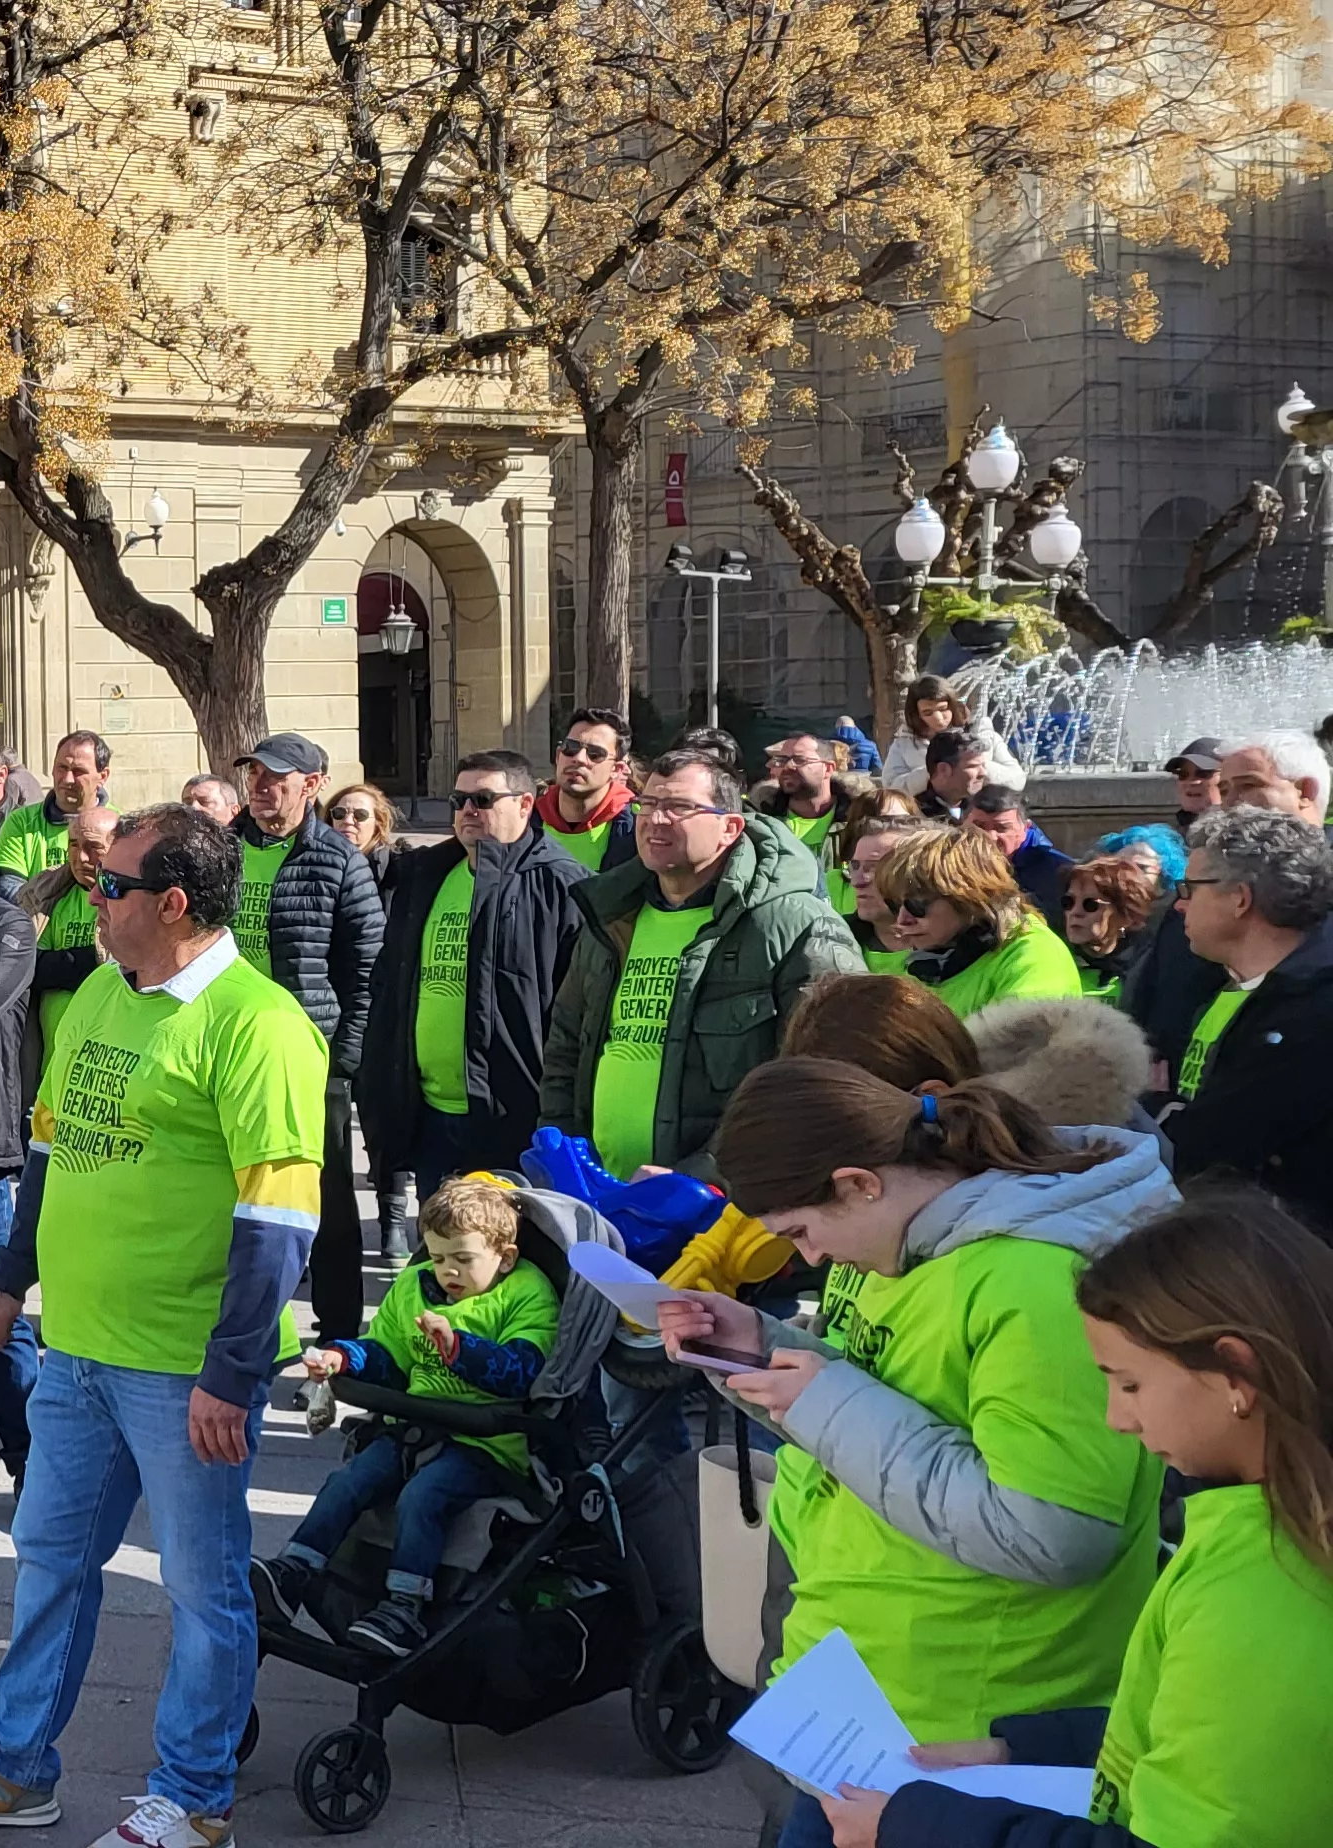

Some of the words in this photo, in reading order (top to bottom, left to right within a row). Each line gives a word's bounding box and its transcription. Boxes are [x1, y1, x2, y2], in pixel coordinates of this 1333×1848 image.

[439, 912, 469, 927] PROY
[433, 944, 468, 961] GENE
[625, 957, 679, 977] PROYEC
[632, 977, 674, 996] INTER
[620, 999, 668, 1020] GENER
[632, 1025, 667, 1044] QUIE
[77, 1039, 140, 1075] PROYECTO
[81, 1066, 128, 1100] INTERES
[62, 1088, 125, 1129] GENERAL
[74, 1127, 116, 1158] QUIEN
[119, 1138, 144, 1164] ??
